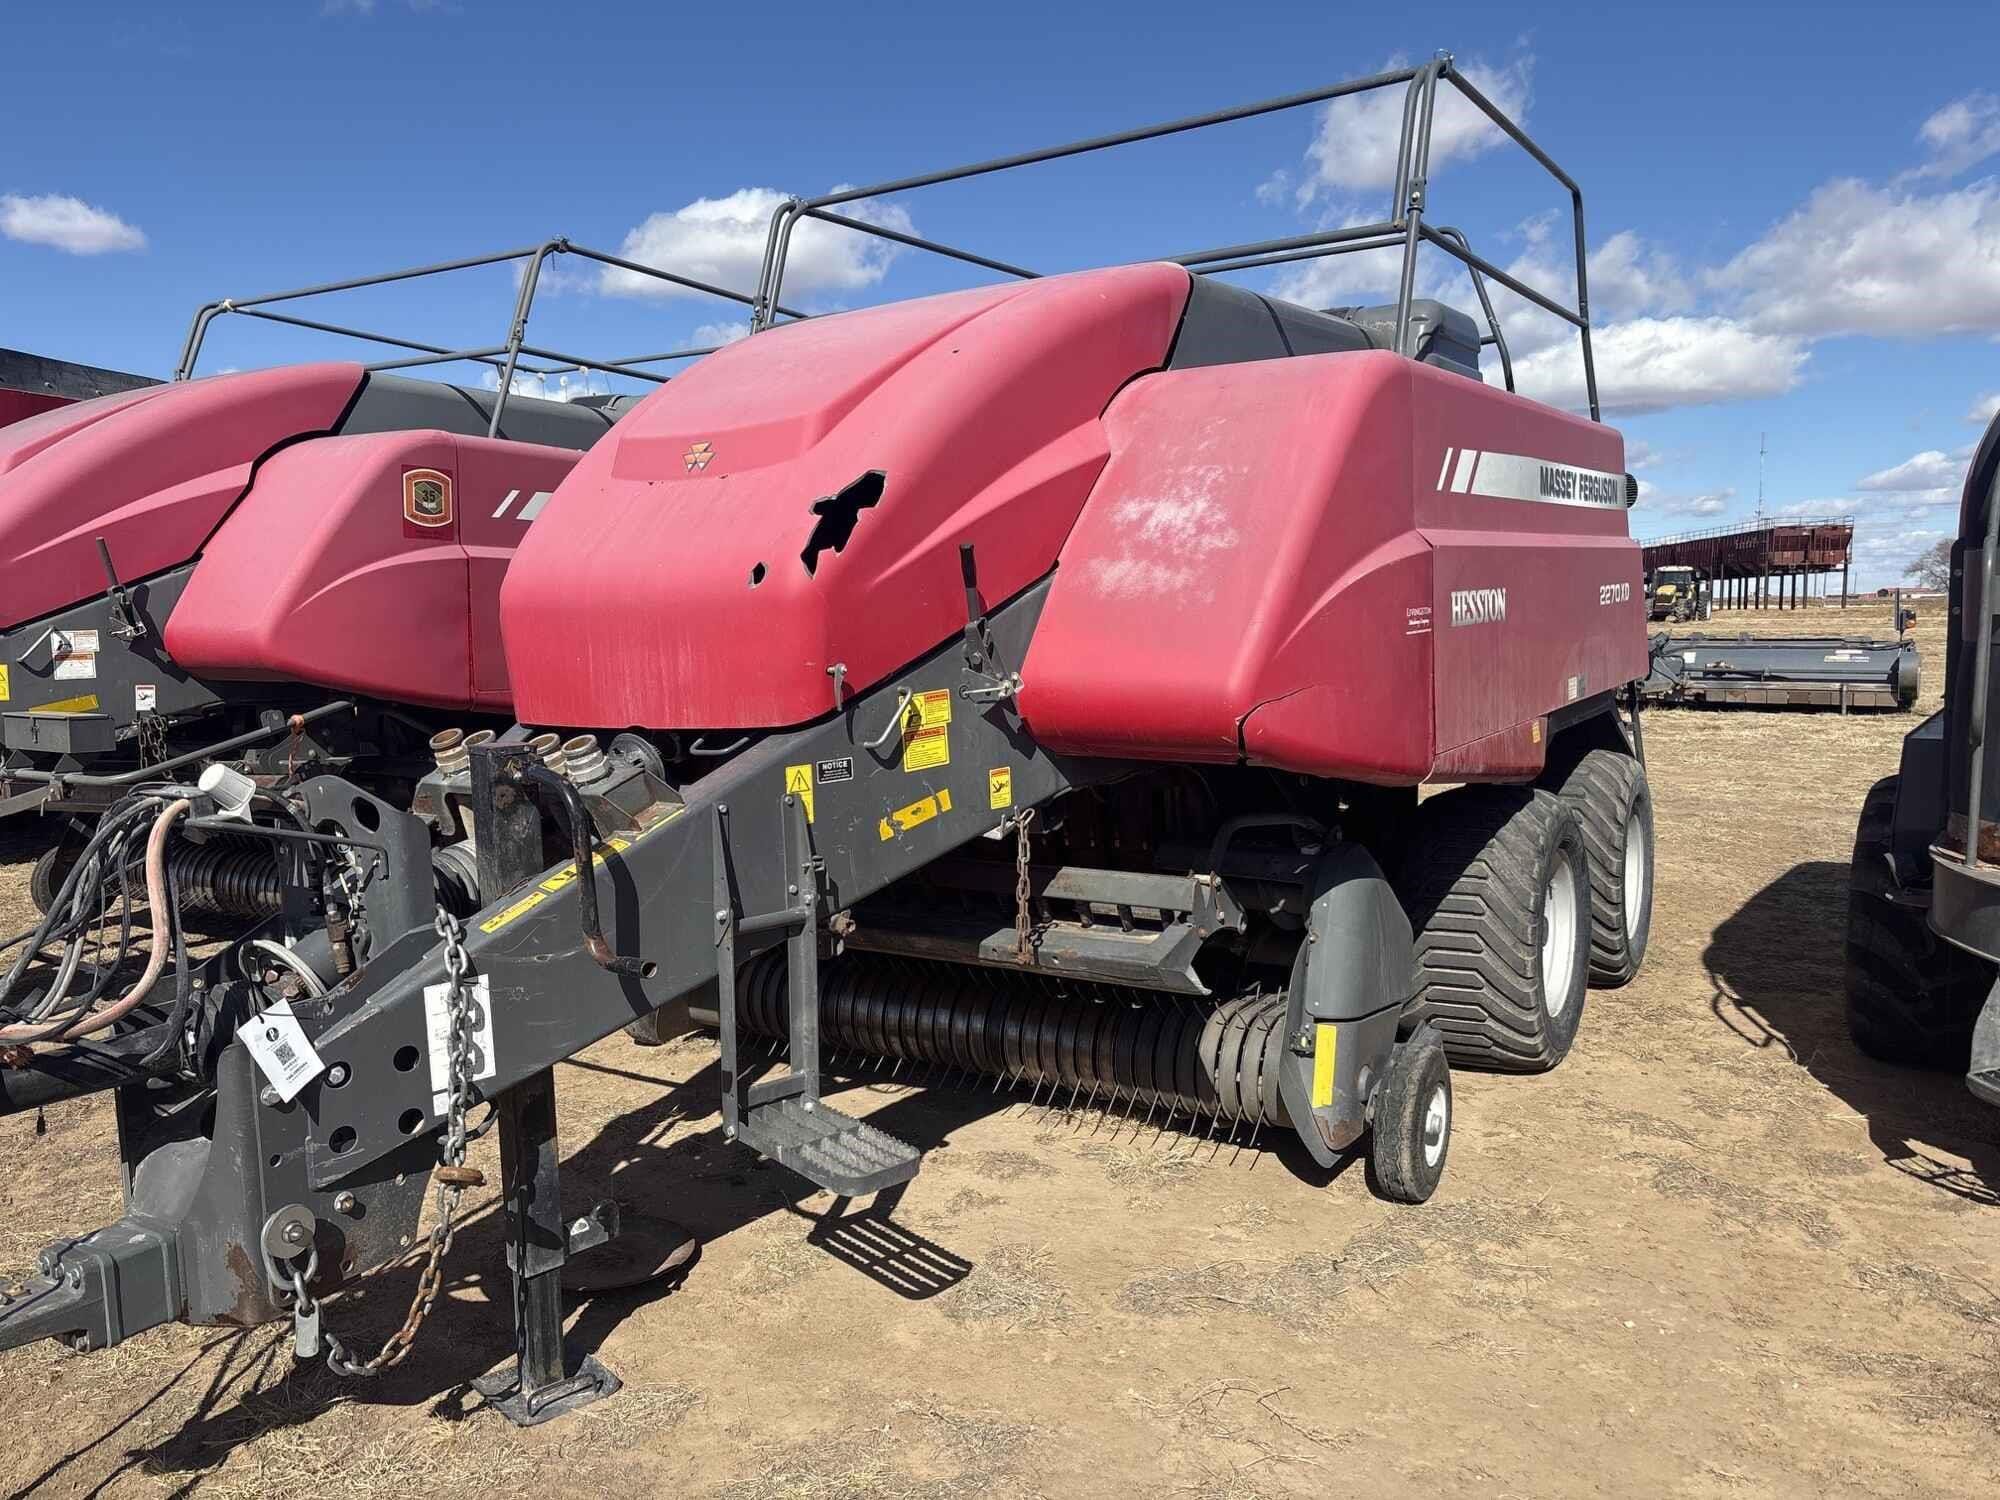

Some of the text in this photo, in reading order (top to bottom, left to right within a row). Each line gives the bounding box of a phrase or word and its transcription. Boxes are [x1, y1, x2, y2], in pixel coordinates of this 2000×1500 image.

[422, 489, 436, 502] 35
[1540, 465, 1618, 504] MASSEY FERGUSON
[1600, 582, 1630, 605] 2270XD
[1451, 588, 1506, 626] HESSTON
[822, 760, 848, 770] NOTICE
